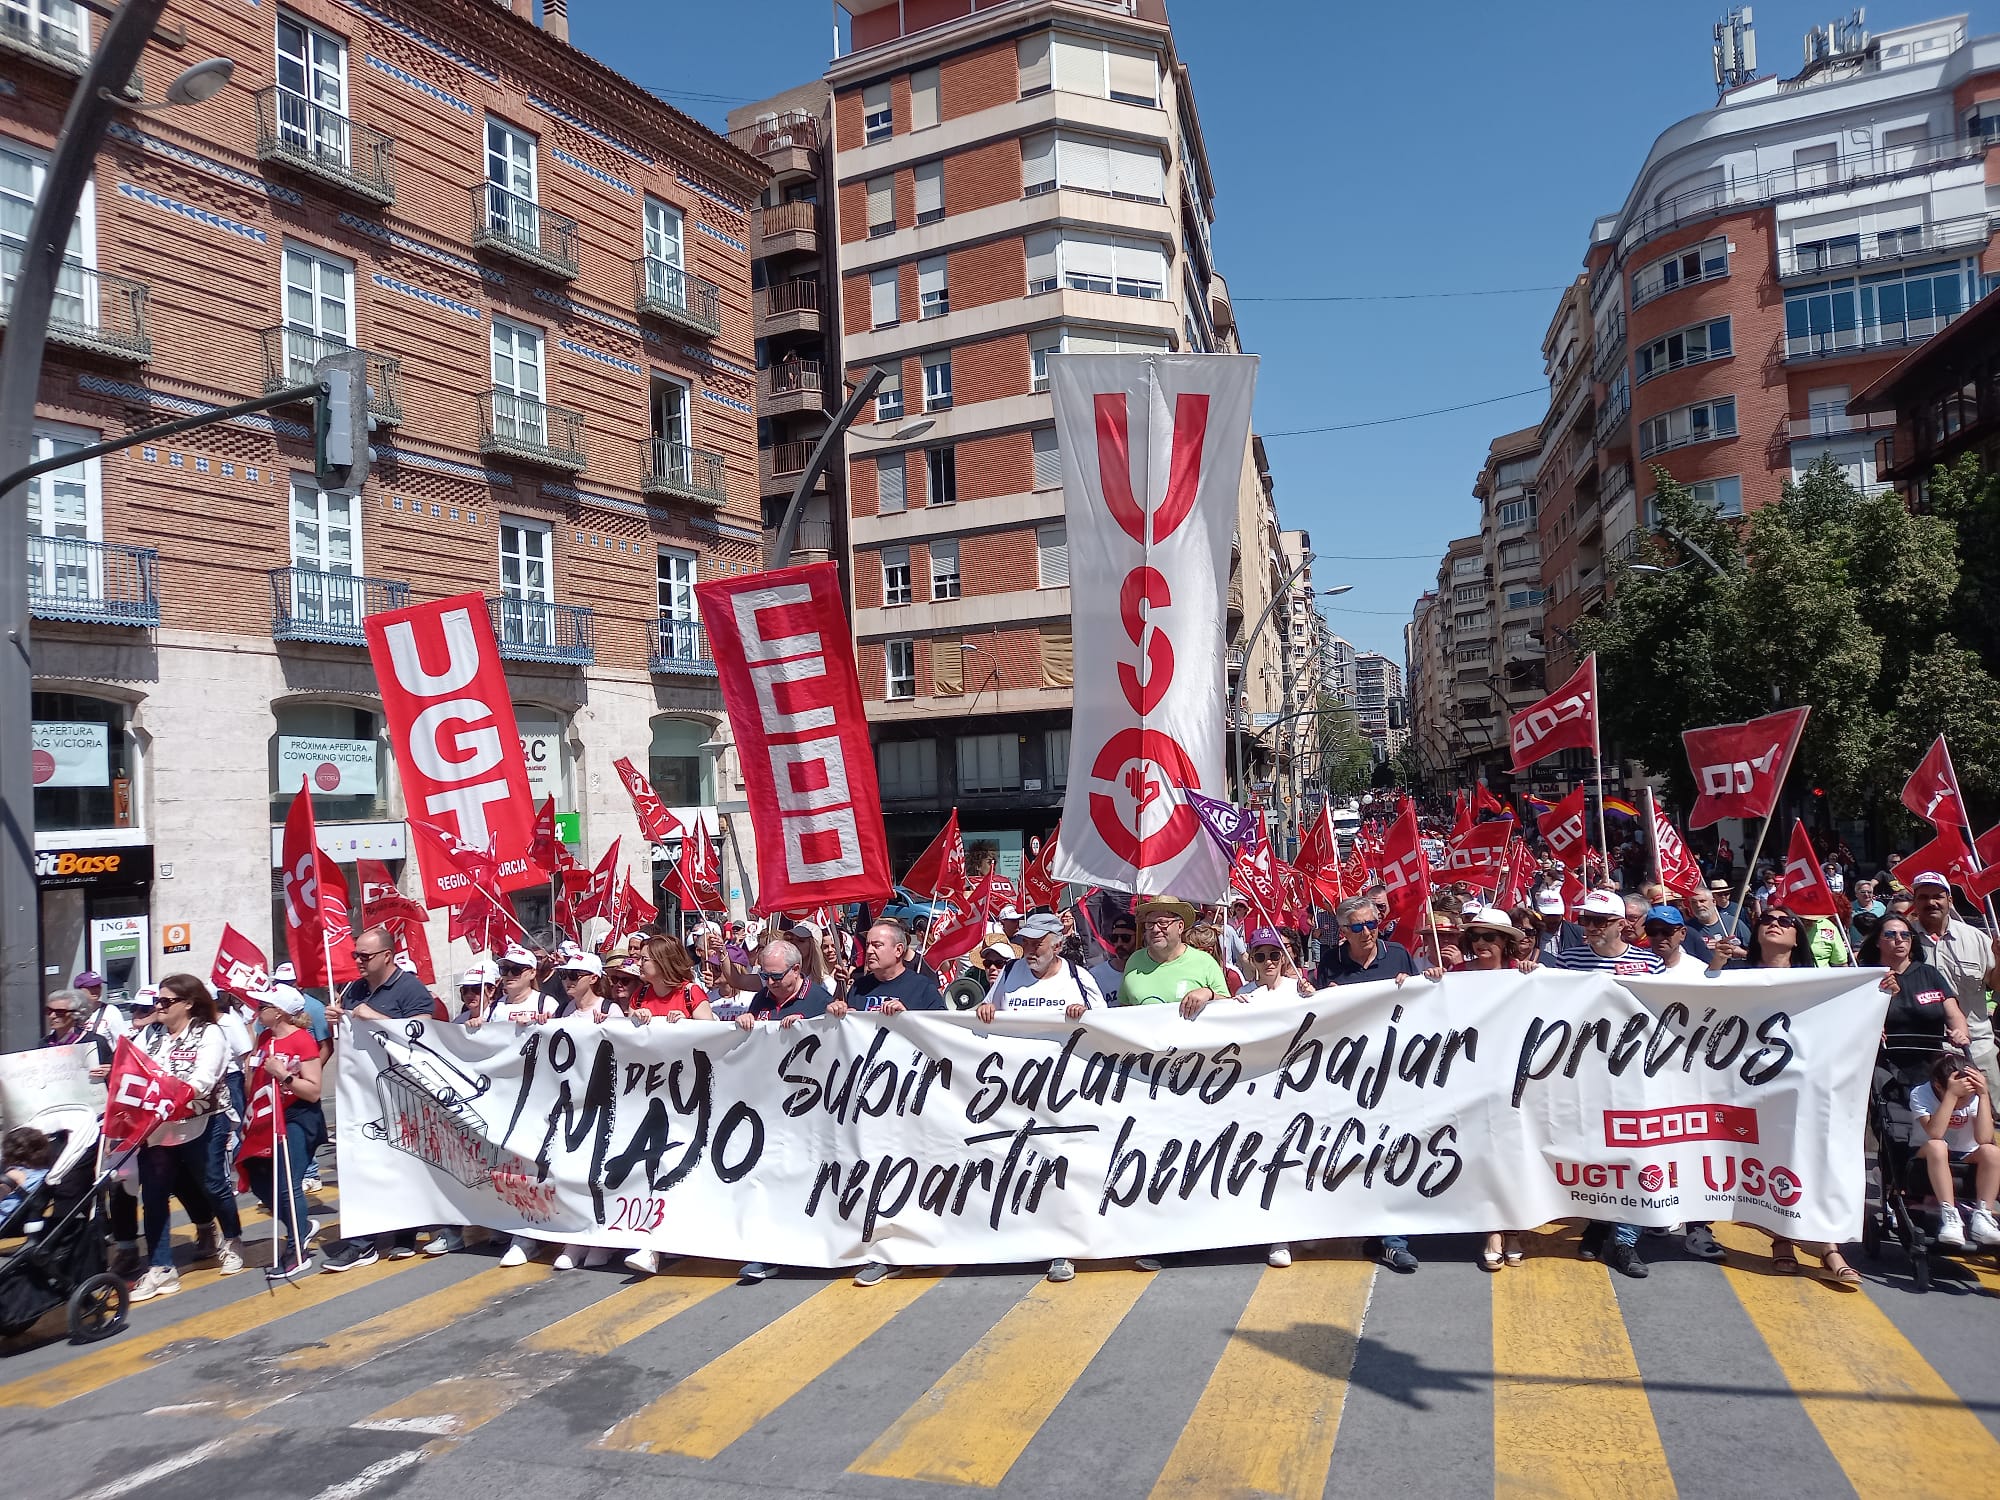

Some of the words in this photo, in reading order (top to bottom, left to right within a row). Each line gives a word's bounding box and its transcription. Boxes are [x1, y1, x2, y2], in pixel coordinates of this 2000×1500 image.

[41, 726, 94, 736] APERTURA
[54, 738, 103, 748] VICTORIA
[384, 607, 511, 855] UGT
[731, 583, 865, 885] CCOO
[283, 751, 337, 761] COWORKING
[338, 754, 373, 763] VICTORIA
[329, 743, 367, 752] APERTURA
[100, 921, 123, 932] ING
[1008, 997, 1066, 1008] #DaElPaso
[778, 1027, 953, 1125] Subir
[1273, 1004, 1478, 1110] bajar
[1511, 1001, 1793, 1108] precios
[623, 1061, 666, 1097] DE
[537, 1040, 765, 1225] MAYO
[1613, 1111, 1709, 1141] CCOO
[804, 1117, 1099, 1243] repartir
[1098, 1112, 1464, 1216] beneficios
[1555, 1161, 1631, 1190] UGT
[1571, 1190, 1617, 1206] Región
[1620, 1194, 1637, 1207] de
[1640, 1194, 1679, 1209] Murcia
[1705, 1193, 1735, 1202] UNIÓN
[1737, 1195, 1773, 1211] SINDICAL
[608, 1197, 666, 1233] 2023
